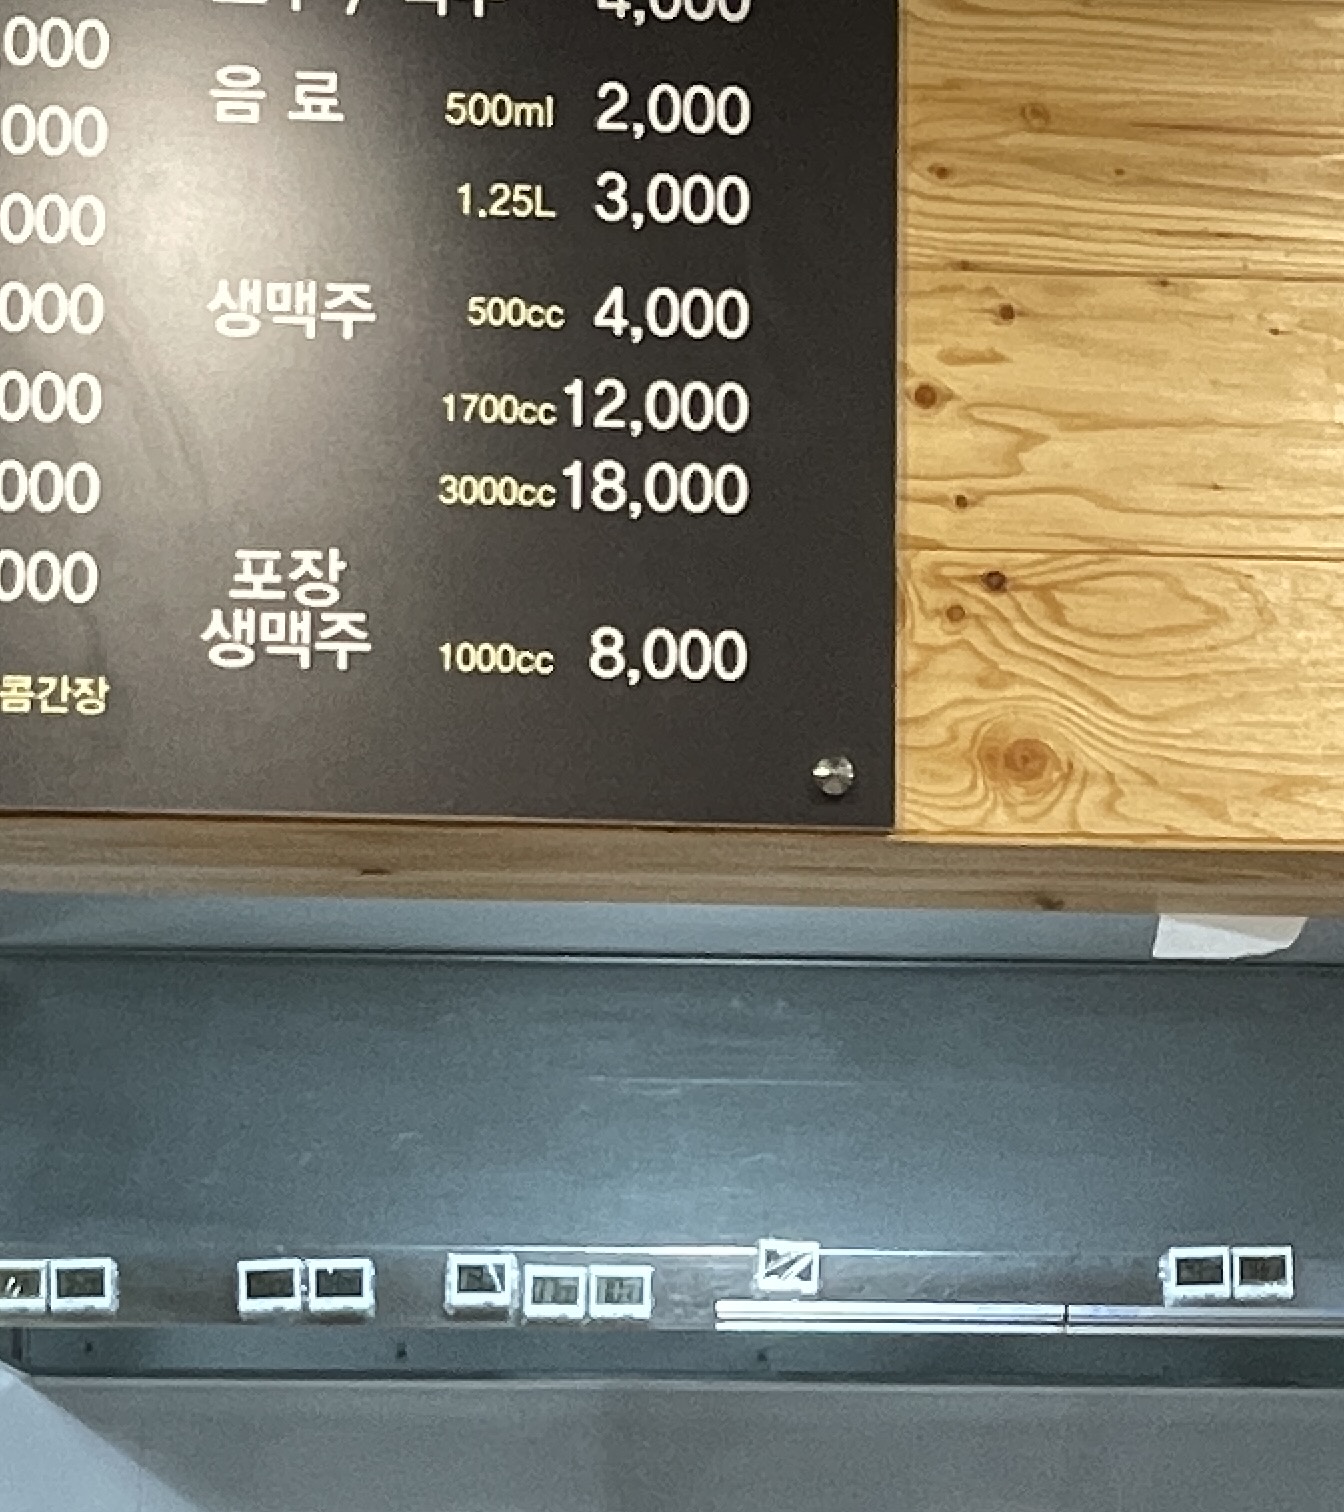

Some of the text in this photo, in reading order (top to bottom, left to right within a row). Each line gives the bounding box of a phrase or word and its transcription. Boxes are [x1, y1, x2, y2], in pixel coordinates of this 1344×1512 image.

[444, 92, 554, 128] 500ml
[596, 80, 750, 140] 2,000
[456, 170, 750, 230] 1.25L 3,000
[206, 279, 750, 344] 생맥주 500cc 4,000
[442, 378, 750, 438] 1700cc 12,000
[438, 458, 748, 520] 3000cc 18,000
[228, 548, 348, 608] 포장
[200, 608, 748, 686] 생맥주 1000cc 8,000
